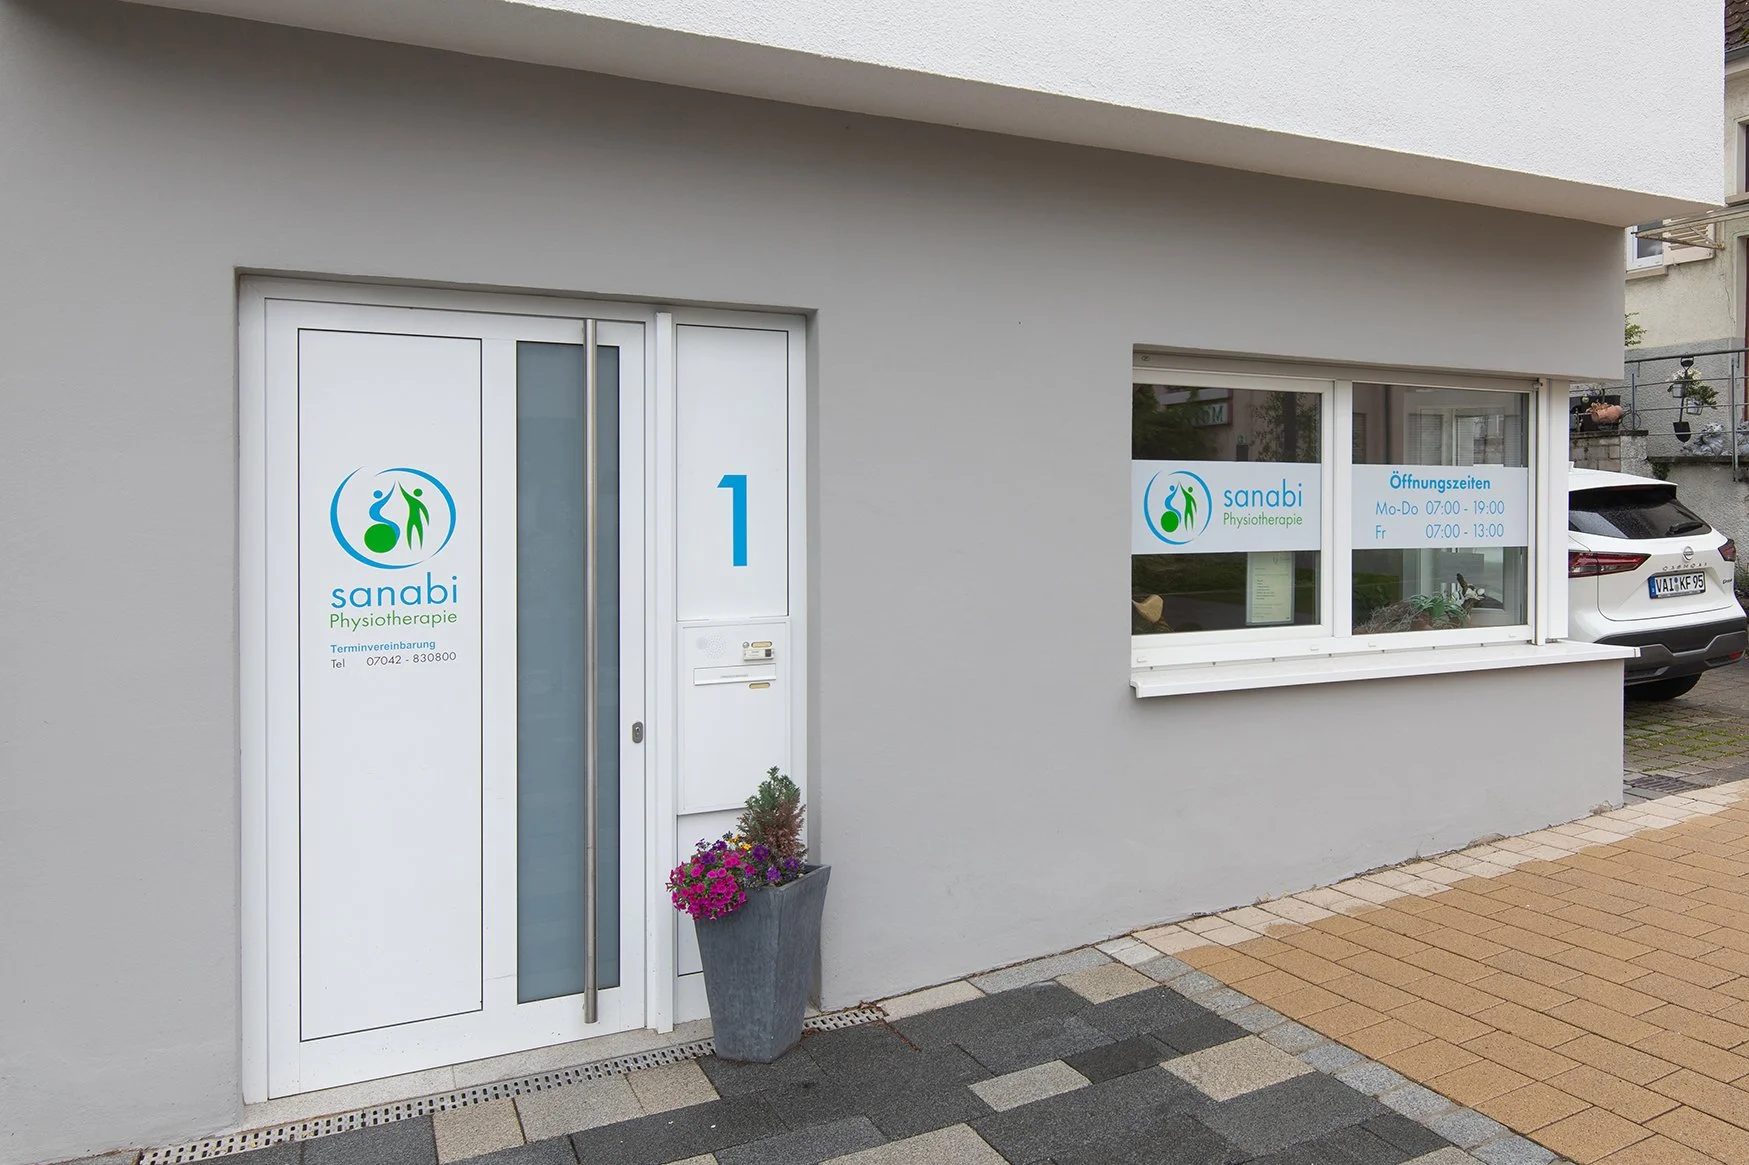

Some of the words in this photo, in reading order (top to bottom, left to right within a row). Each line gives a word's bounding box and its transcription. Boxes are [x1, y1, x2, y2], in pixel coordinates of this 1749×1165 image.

[1389, 470, 1491, 494] Öffnungszeiten
[1223, 478, 1303, 508] sanabi
[1375, 500, 1419, 516] Mo-Do
[1425, 500, 1460, 515] 07:00
[1473, 500, 1505, 515] 19:00
[717, 474, 748, 567] 1
[1223, 511, 1303, 529] Physiotherapie
[1375, 524, 1387, 540] Fr
[1425, 523, 1461, 539] 07:00
[1473, 523, 1505, 538] 13:00
[331, 571, 458, 609] sanabi
[1656, 578, 1674, 592] VAI
[1680, 575, 1691, 590] KF
[1692, 575, 1704, 588] 95
[330, 610, 458, 632] Physiotherapie
[330, 641, 436, 654] Terminvereinbarung
[331, 658, 346, 669] Tel
[366, 655, 402, 666] 07042
[412, 651, 457, 664] 830800
